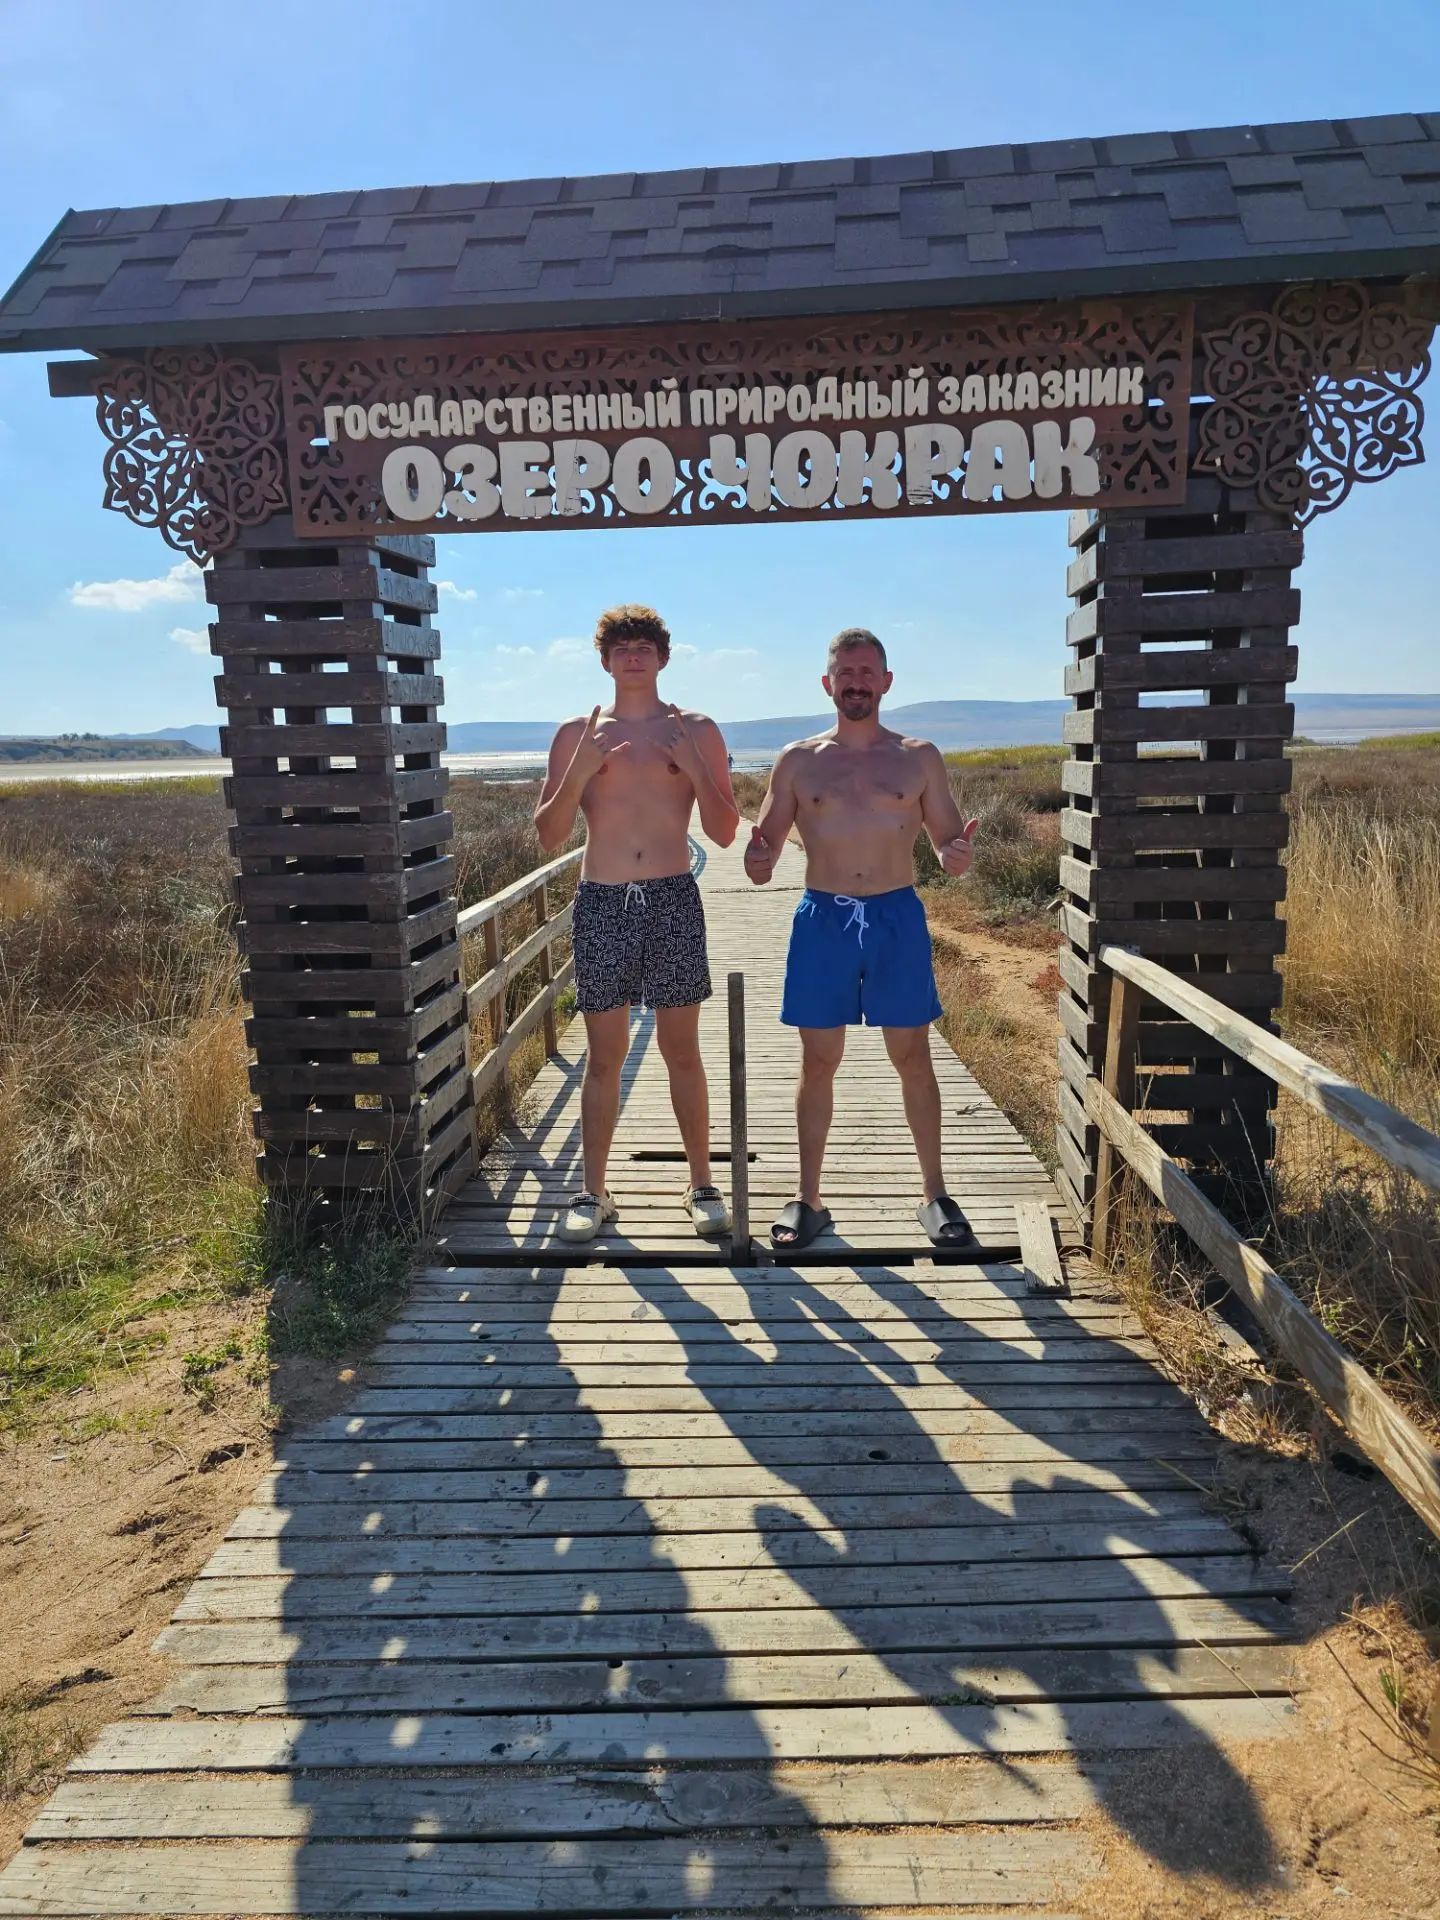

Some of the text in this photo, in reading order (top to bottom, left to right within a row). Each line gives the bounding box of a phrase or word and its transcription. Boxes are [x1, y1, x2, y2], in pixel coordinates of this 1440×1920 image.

[324, 365, 1144, 442] ГОСУДАРСТВЕННЫЙ ПРИРОДНЫЙ ЗАКАЗНИК
[381, 416, 1102, 521] ОЗЕРО ЧОКРАК
